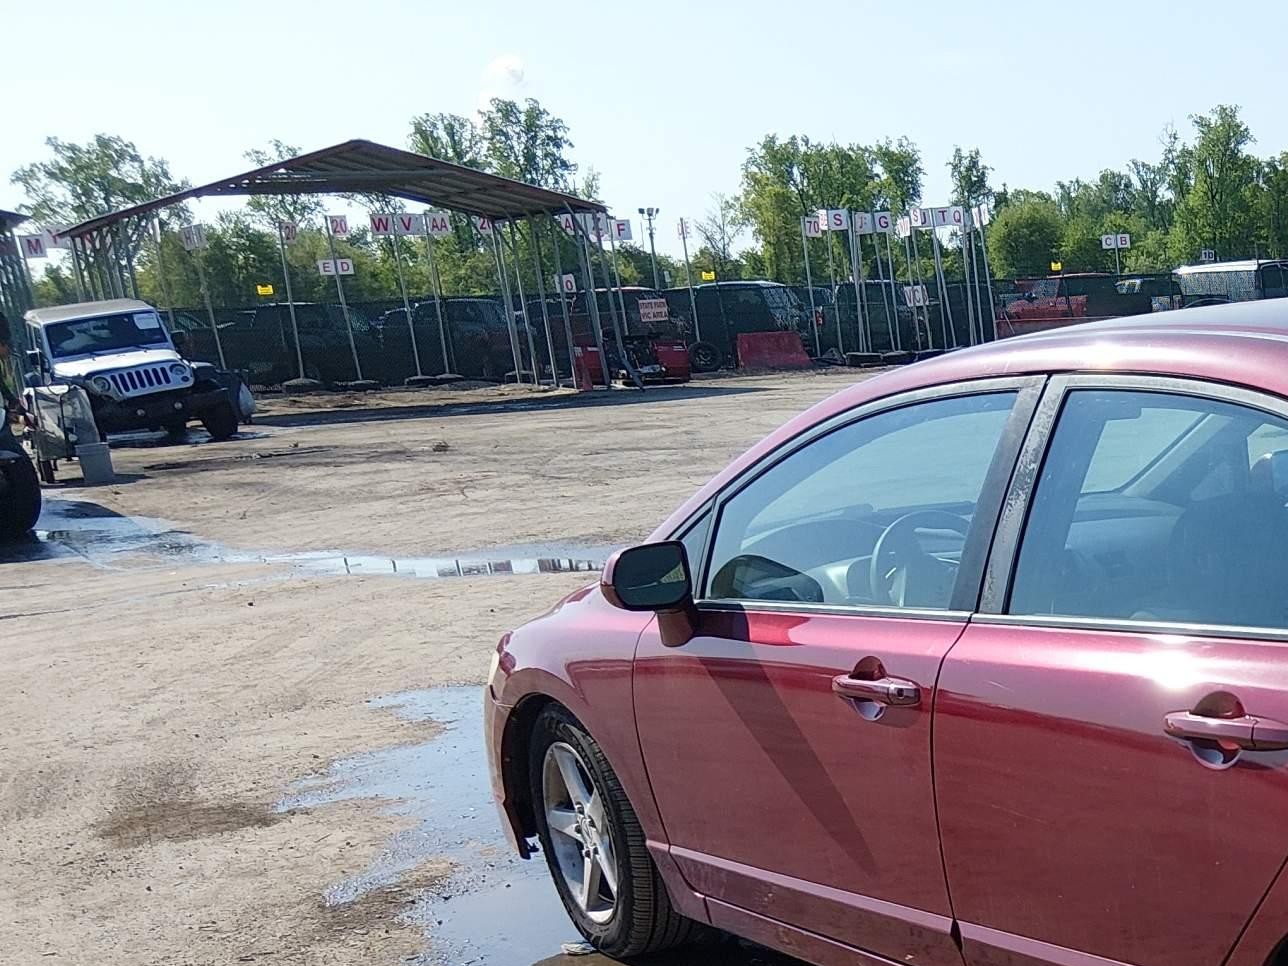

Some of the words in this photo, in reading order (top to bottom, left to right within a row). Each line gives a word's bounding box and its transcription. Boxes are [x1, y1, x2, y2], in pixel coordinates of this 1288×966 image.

[833, 213, 843, 226] S
[878, 215, 889, 228] G
[938, 210, 947, 223] T
[953, 210, 962, 223] Q
[331, 218, 348, 233] 20
[371, 217, 389, 231] W
[400, 217, 411, 231] V
[431, 217, 449, 231] AA
[617, 223, 625, 236] F
[806, 220, 820, 233] 70
[284, 225, 296, 240] 20
[26, 238, 43, 255] M
[1105, 237, 1113, 246] C
[1120, 236, 1127, 245] B
[322, 262, 332, 272] E
[341, 261, 350, 272] D
